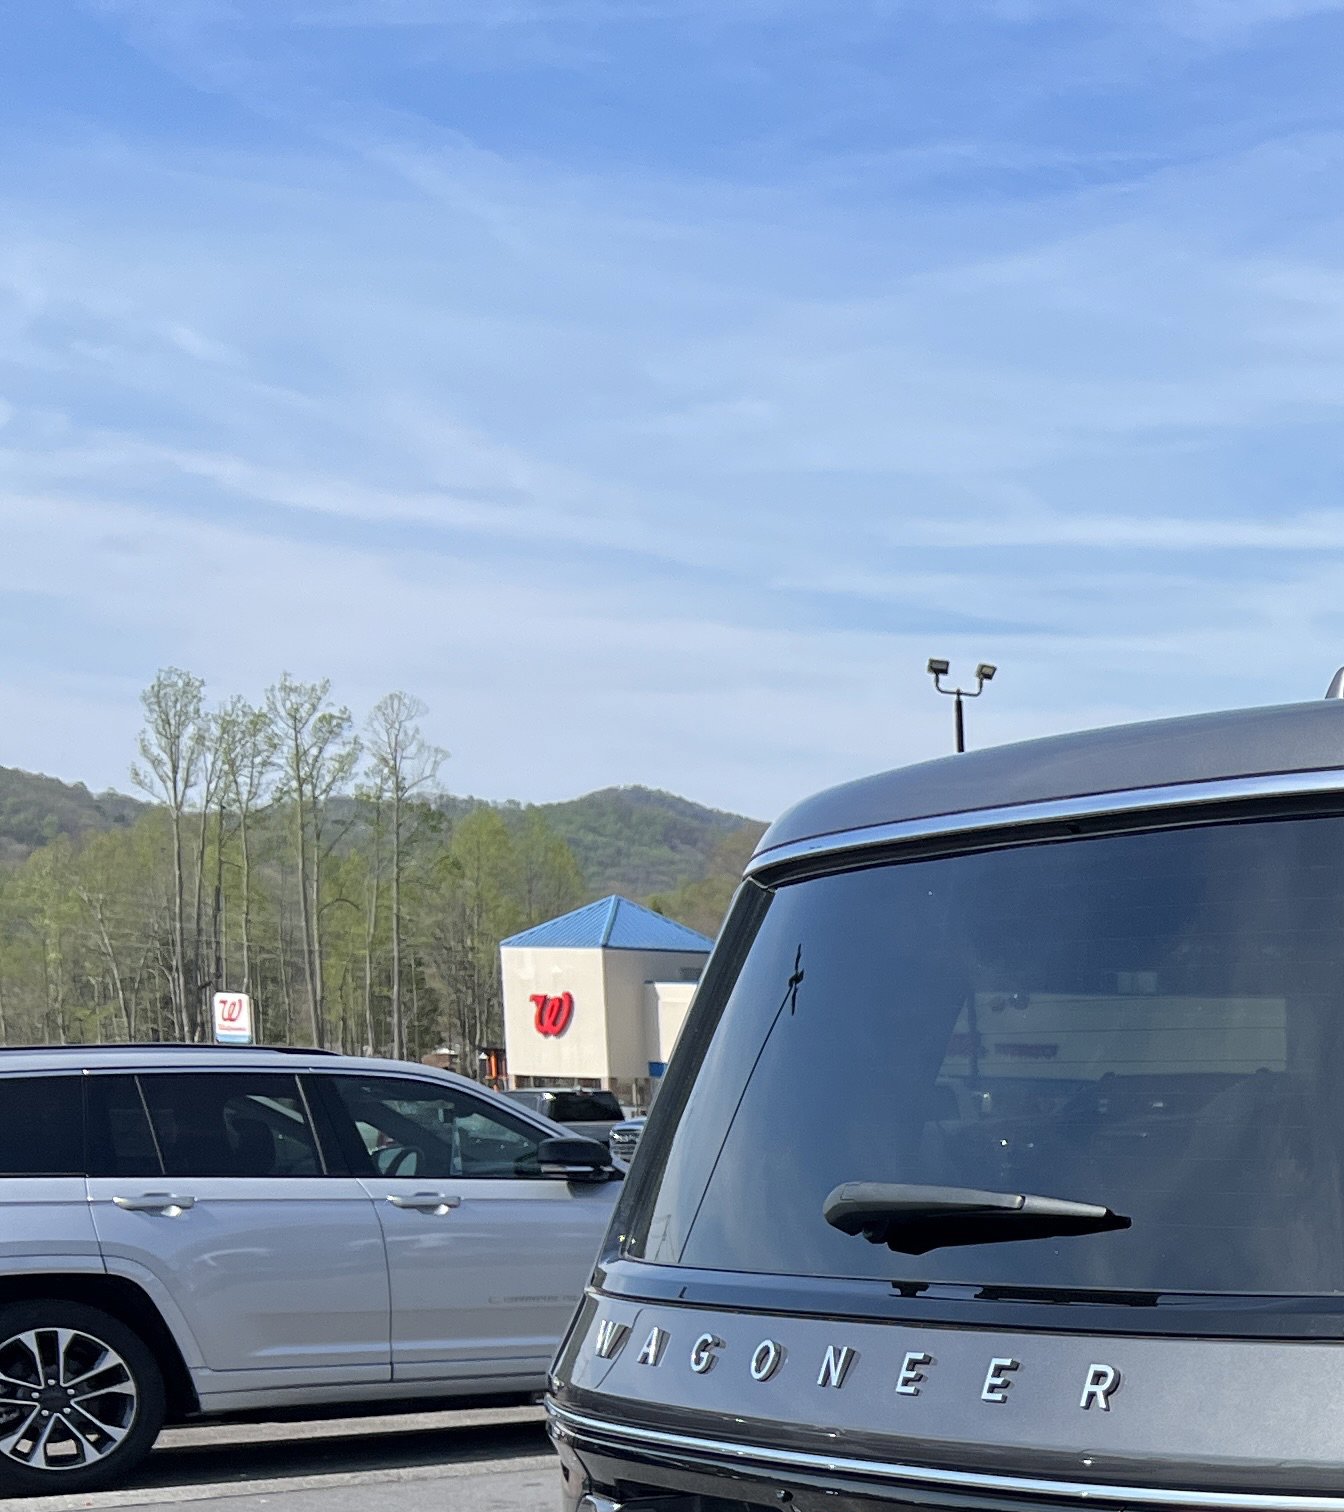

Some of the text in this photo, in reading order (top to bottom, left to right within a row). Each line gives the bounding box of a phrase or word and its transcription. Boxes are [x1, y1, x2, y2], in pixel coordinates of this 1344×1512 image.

[219, 999, 242, 1021] W
[529, 991, 574, 1036] W
[595, 1319, 1121, 1411] WAGONEER
